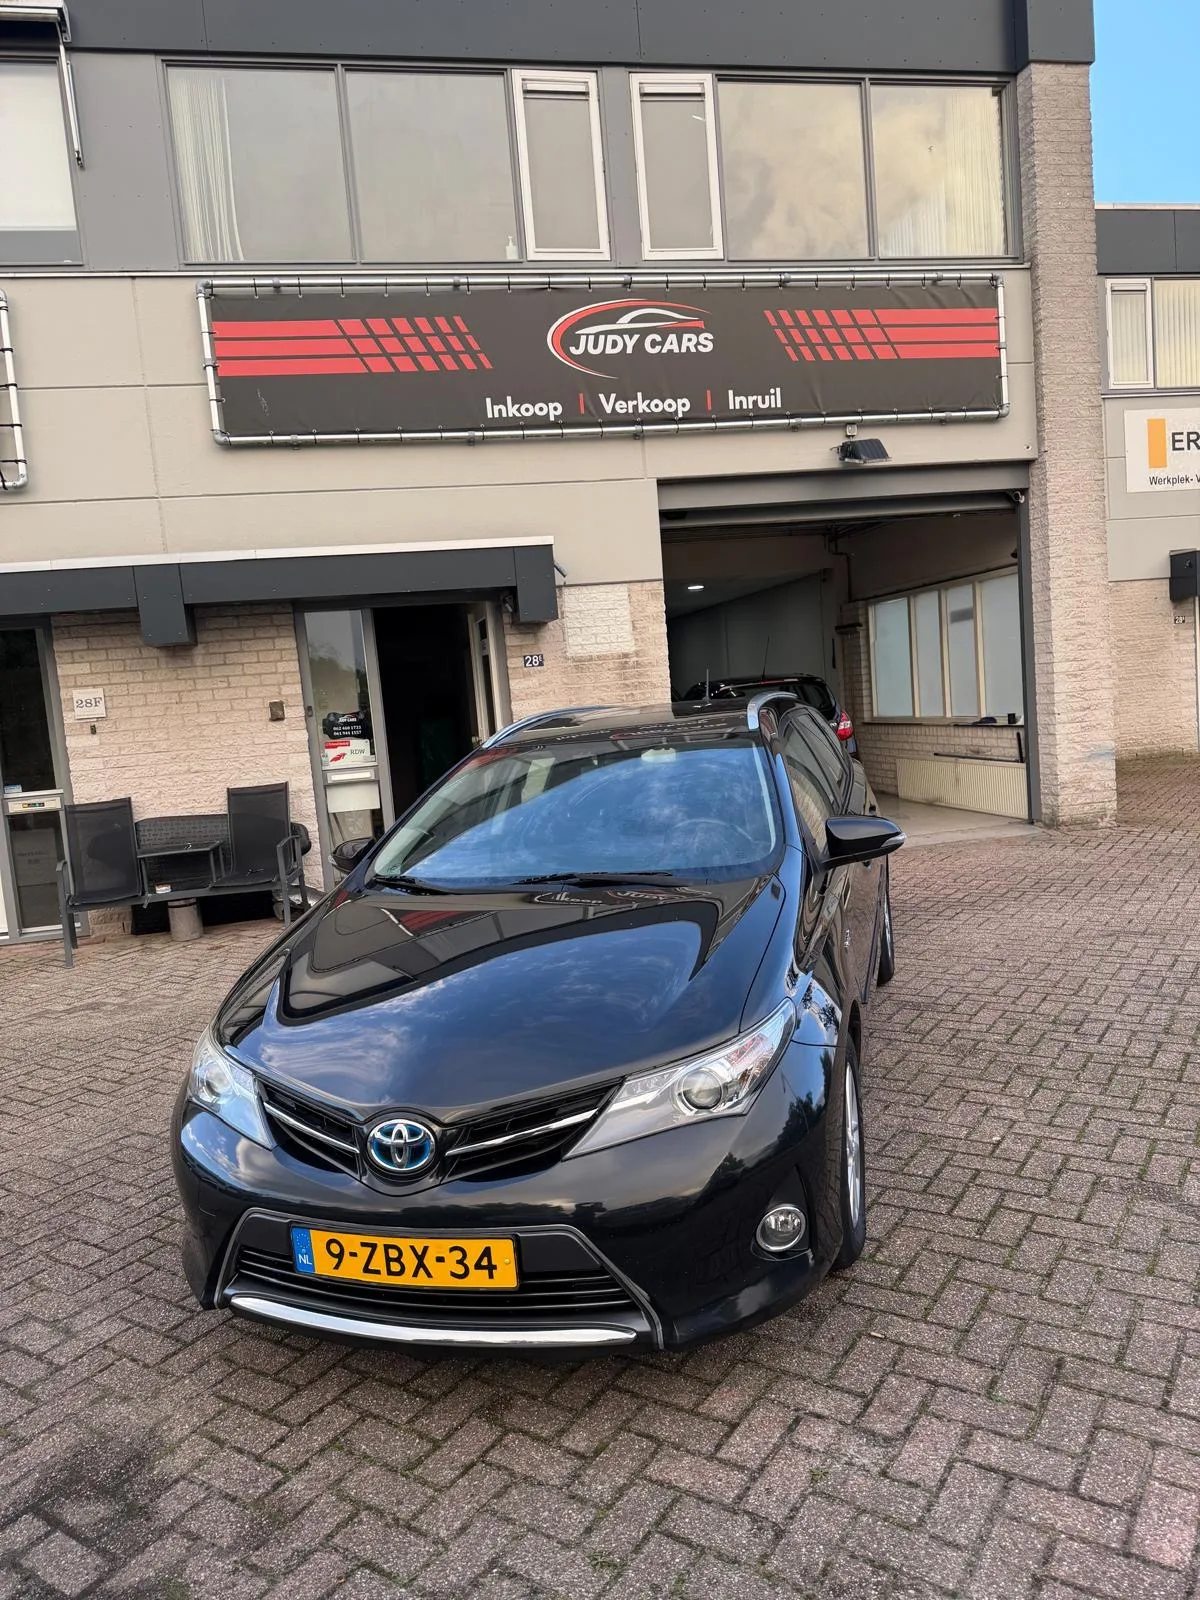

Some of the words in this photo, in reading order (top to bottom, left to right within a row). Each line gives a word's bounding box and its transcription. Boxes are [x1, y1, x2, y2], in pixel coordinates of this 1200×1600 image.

[569, 334, 640, 354] JUDY
[644, 332, 714, 353] CARS
[485, 396, 563, 421] Inkoop
[599, 392, 691, 417] Verkoop
[728, 387, 783, 410] Inruil
[1149, 475, 1193, 486] Werkplek-
[76, 697, 102, 708] 28F
[298, 1254, 312, 1265] NL
[325, 1238, 498, 1280] 9-ZBX-34
